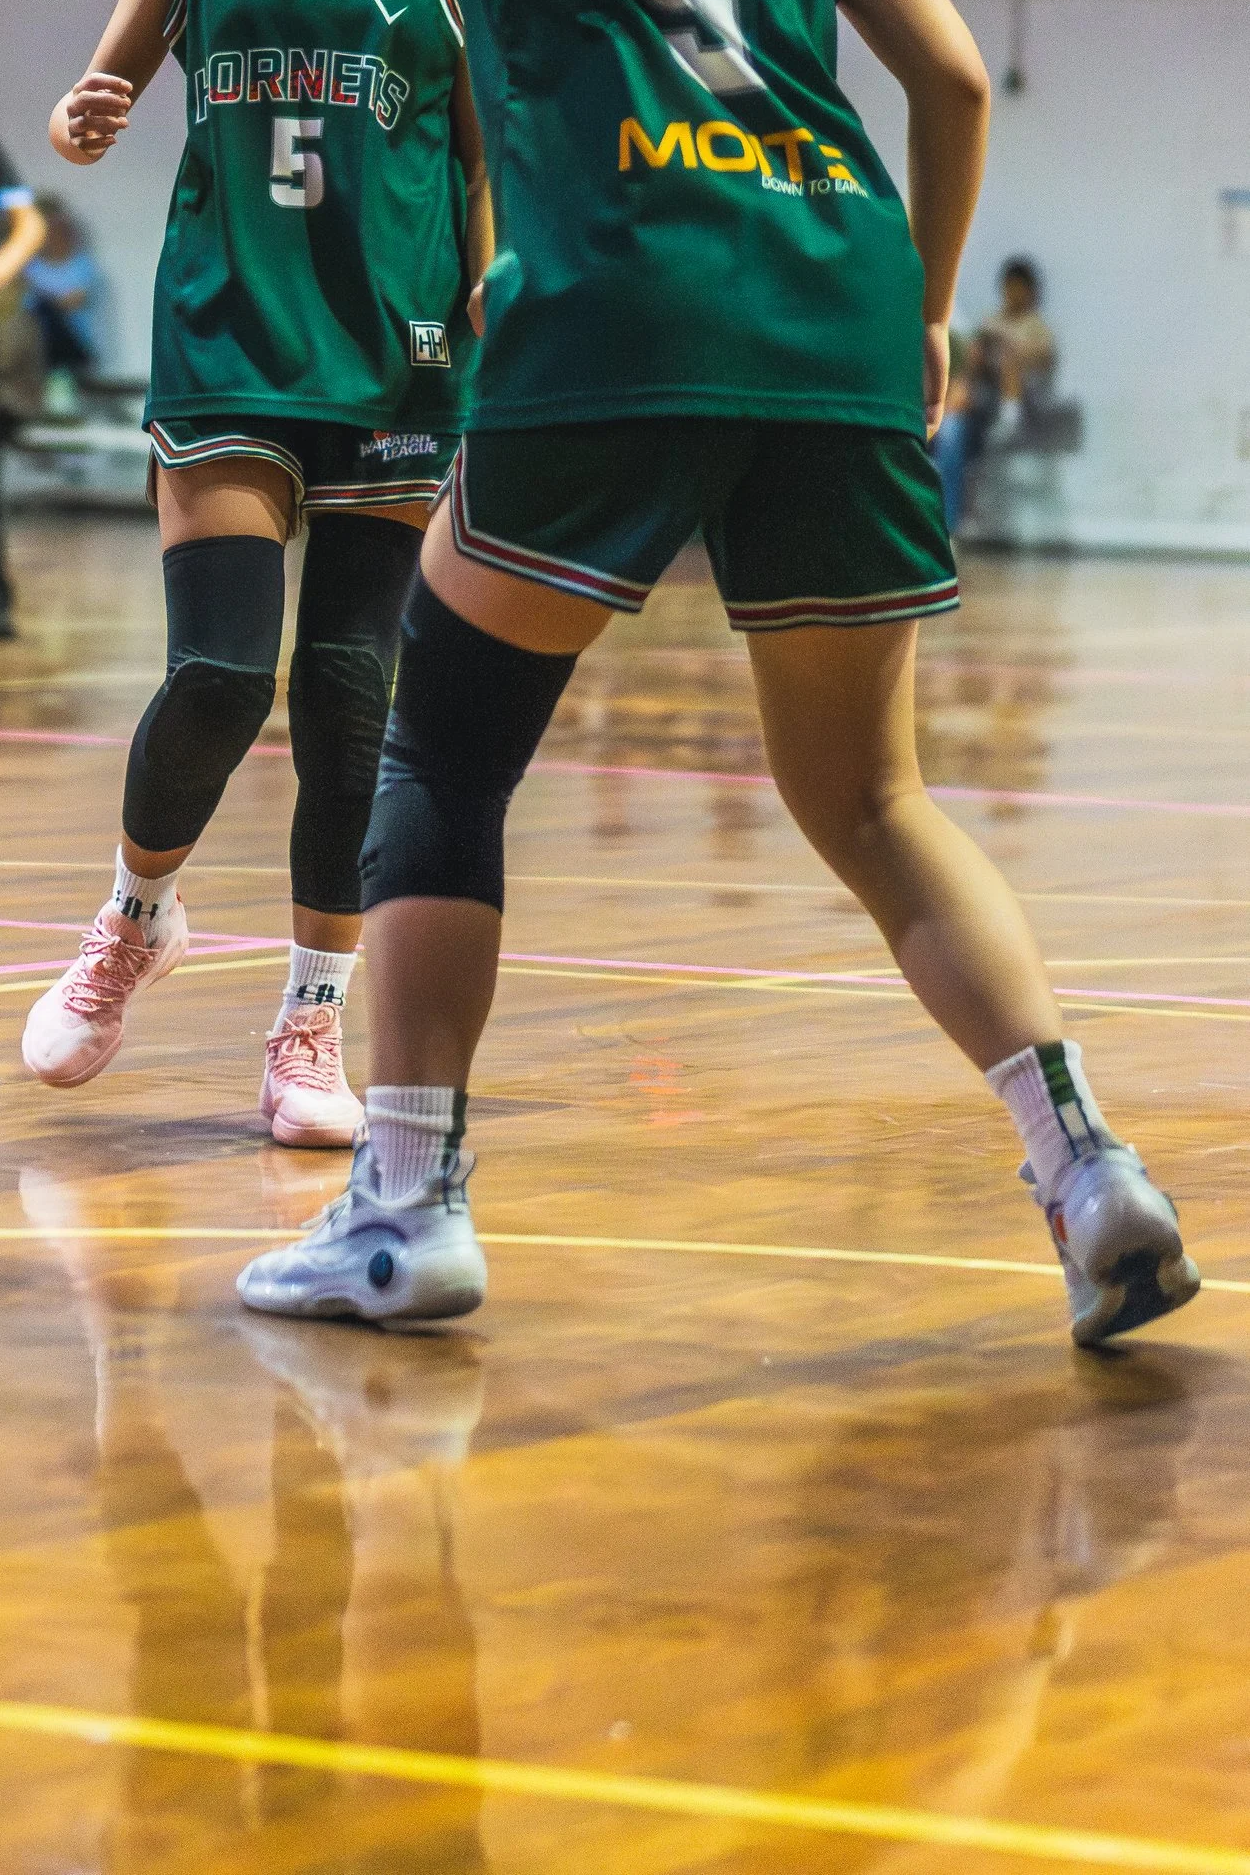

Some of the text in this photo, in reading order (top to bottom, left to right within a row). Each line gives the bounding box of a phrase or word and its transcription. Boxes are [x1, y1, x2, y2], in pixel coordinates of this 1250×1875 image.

[268, 115, 325, 209] 5
[761, 175, 804, 197] DOWN
[809, 178, 831, 197] TO
[382, 440, 439, 463] LEAGUE
